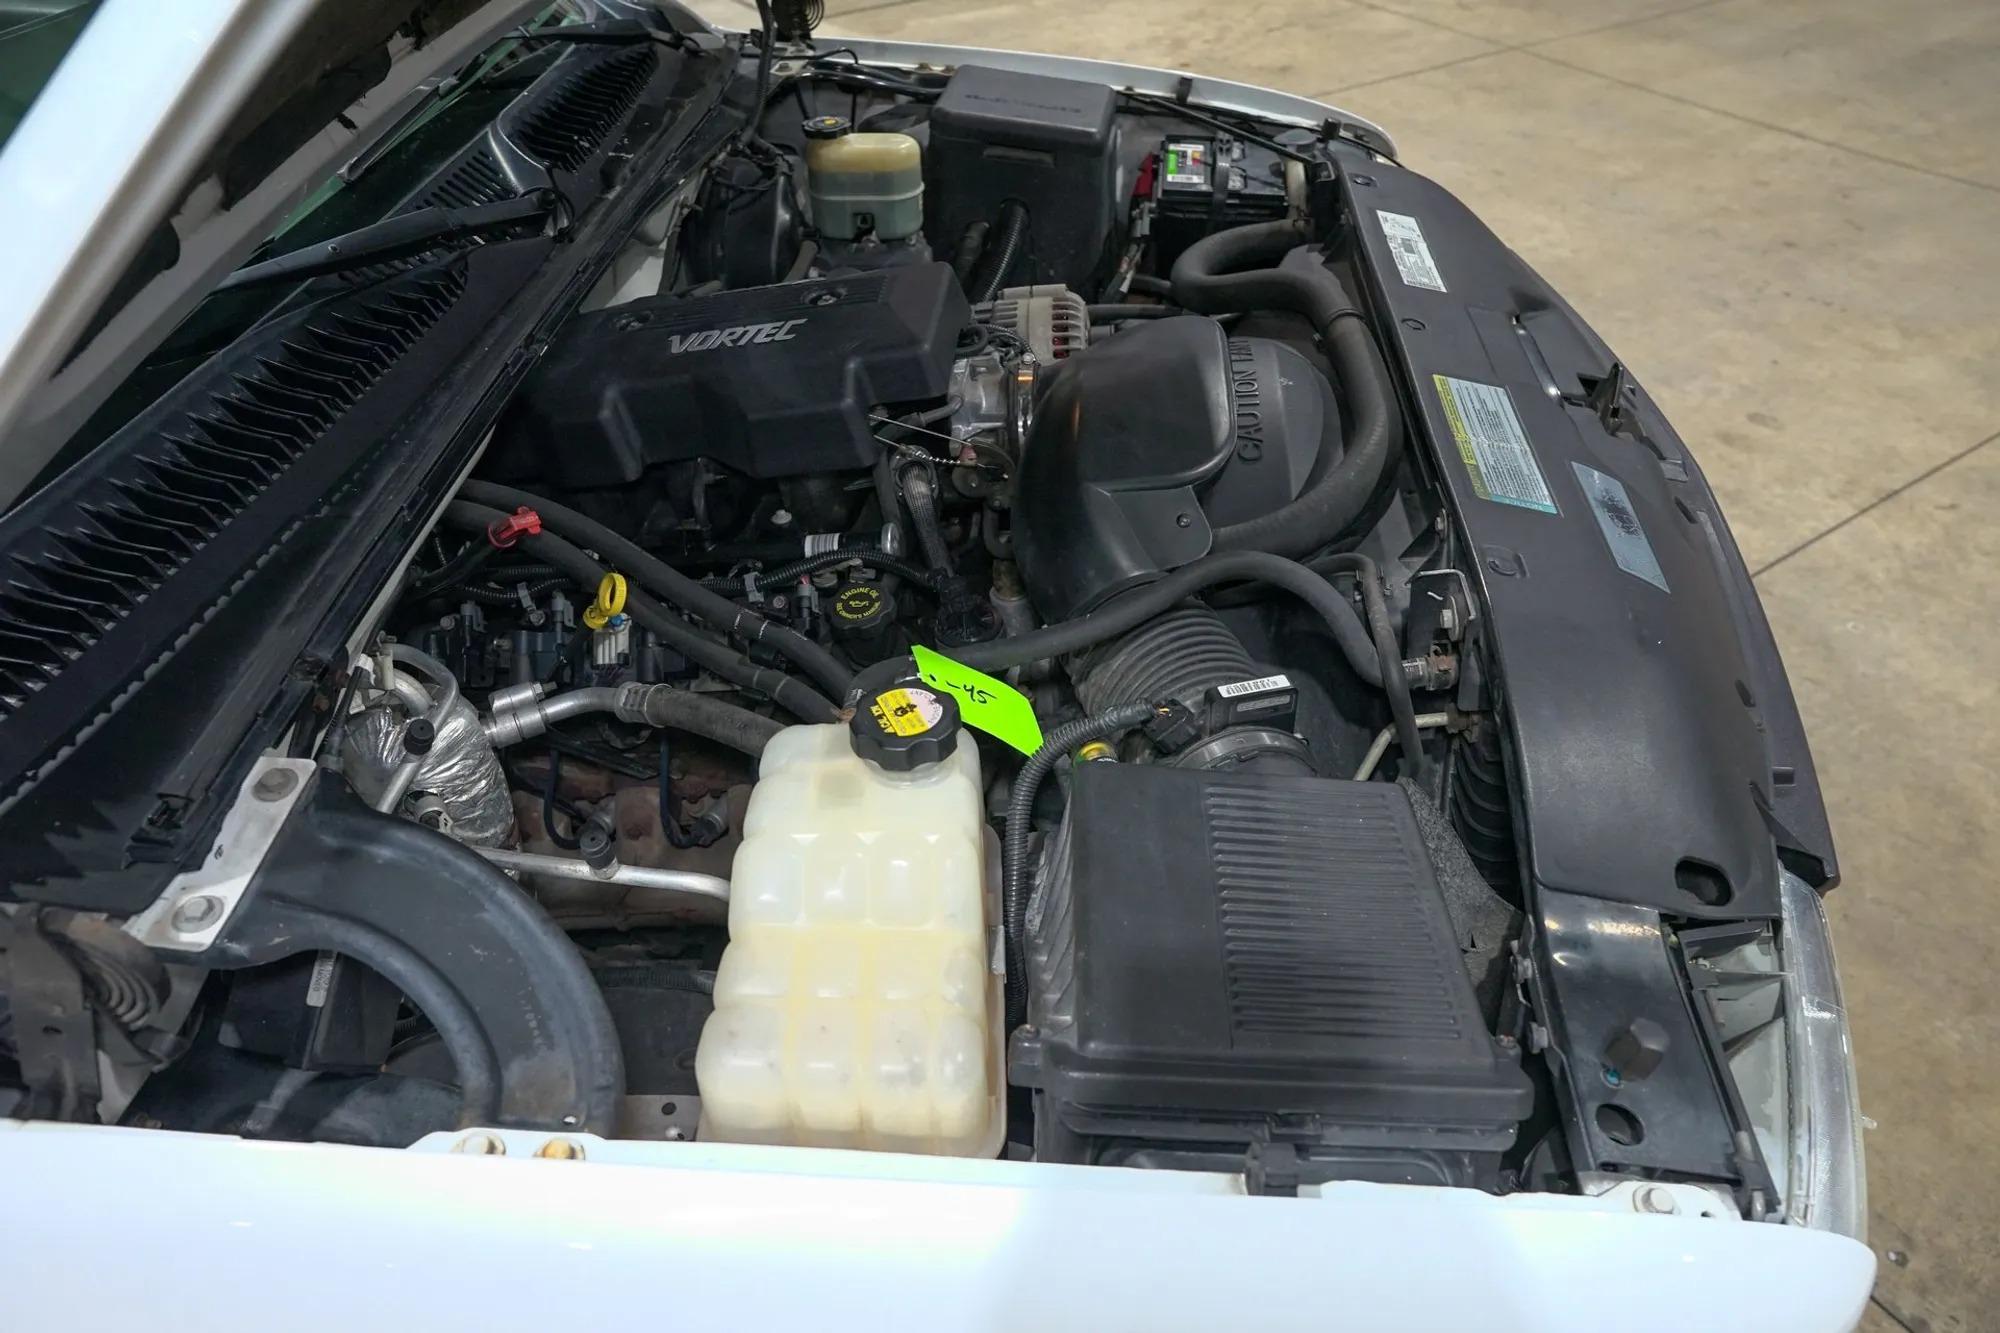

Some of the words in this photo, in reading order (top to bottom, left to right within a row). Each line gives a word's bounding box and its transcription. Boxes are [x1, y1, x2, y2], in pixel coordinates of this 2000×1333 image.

[668, 318, 808, 354] VORTEC
[1232, 370, 1263, 462] CAUTION
[840, 587, 871, 600] ENGINE
